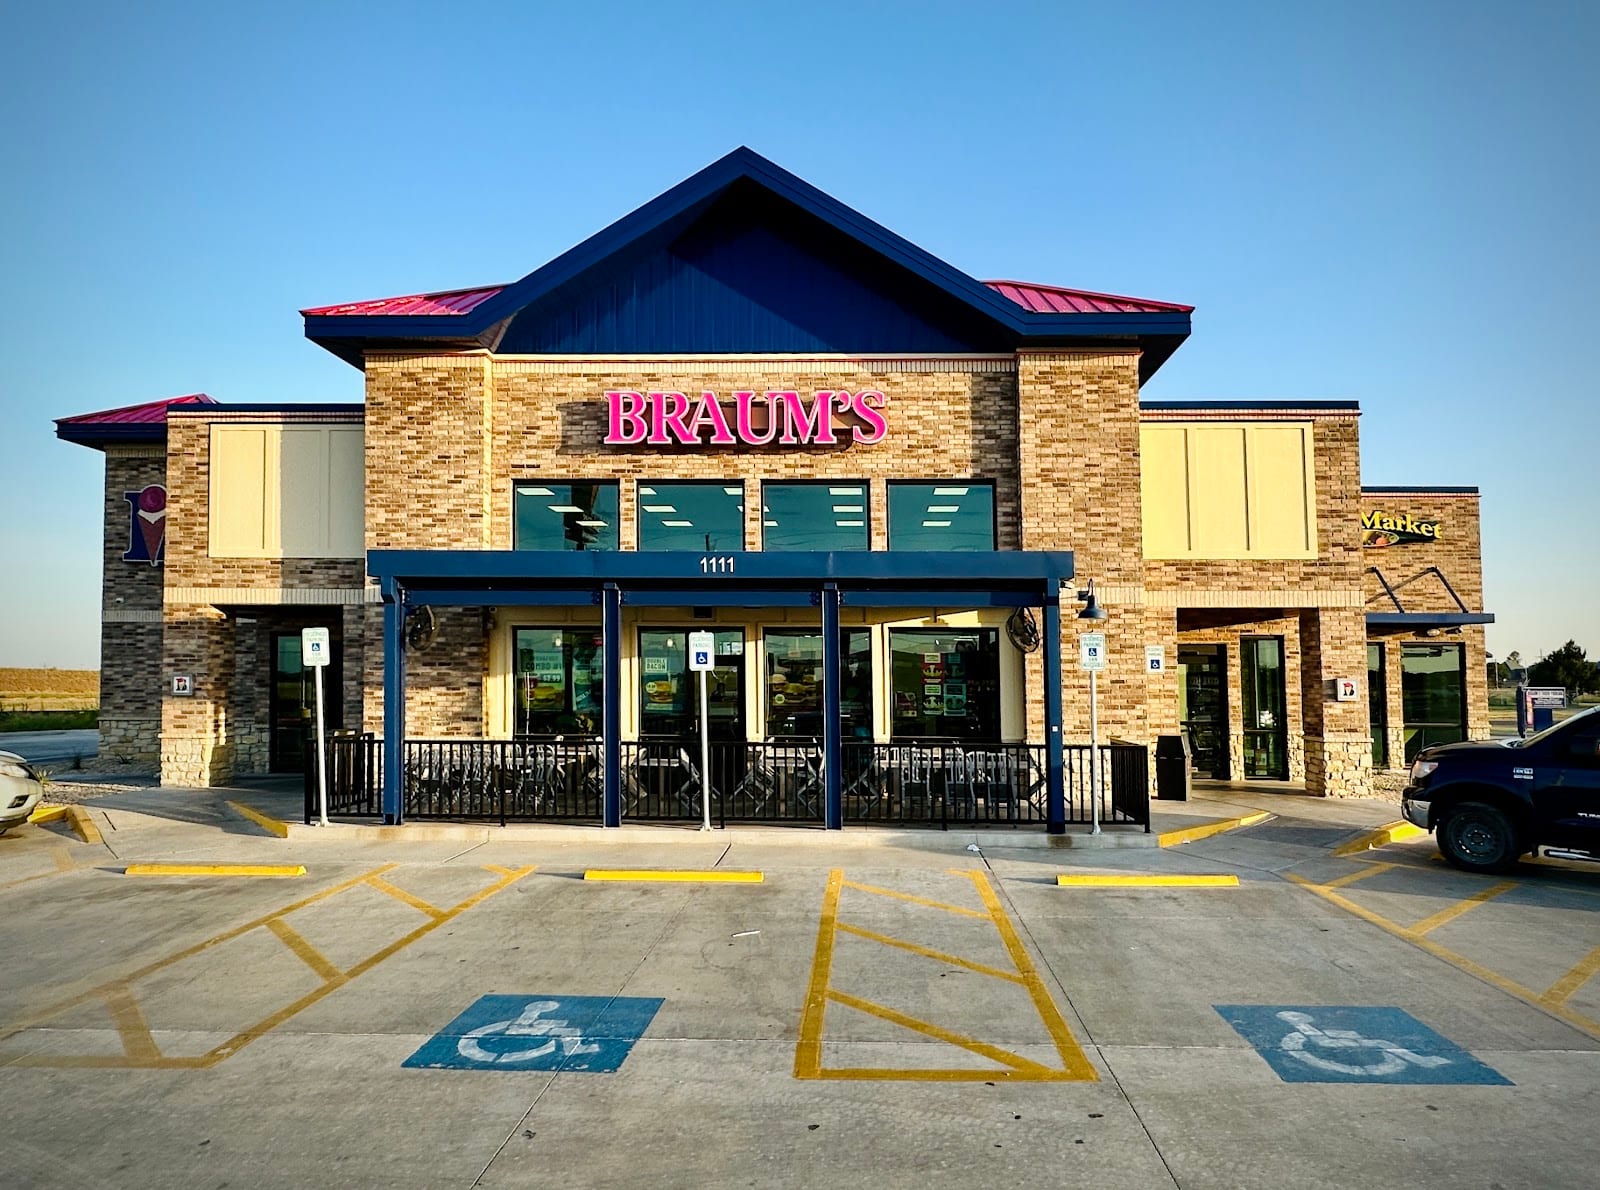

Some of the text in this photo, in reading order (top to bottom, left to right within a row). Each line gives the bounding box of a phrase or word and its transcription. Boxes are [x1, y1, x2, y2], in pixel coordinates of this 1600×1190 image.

[603, 390, 888, 445] BRAUM'S
[1361, 510, 1442, 539] Market
[700, 556, 734, 573] 1111
